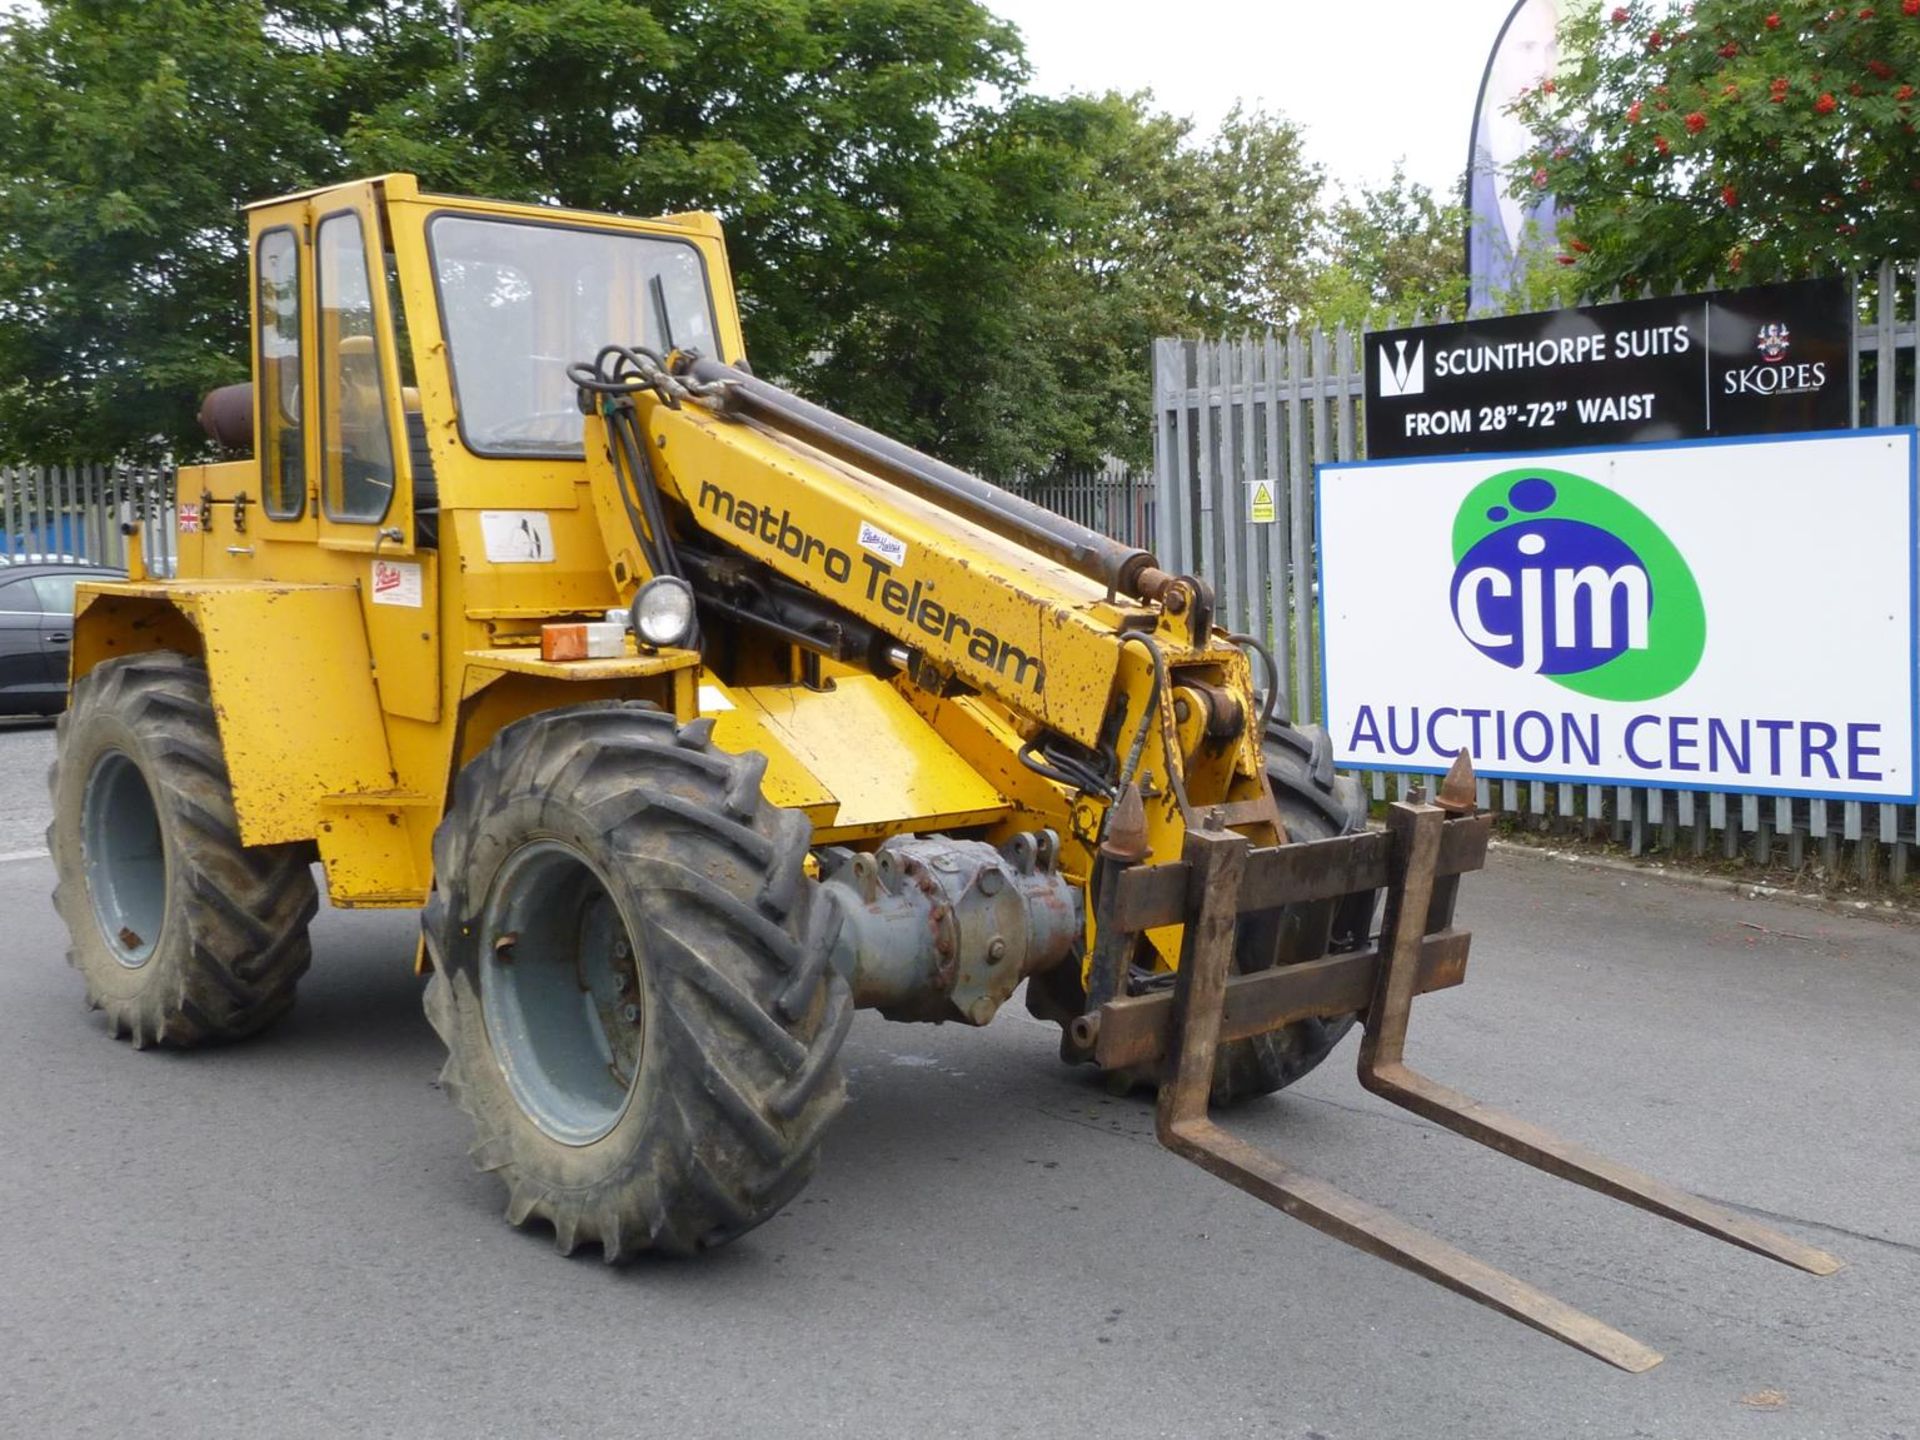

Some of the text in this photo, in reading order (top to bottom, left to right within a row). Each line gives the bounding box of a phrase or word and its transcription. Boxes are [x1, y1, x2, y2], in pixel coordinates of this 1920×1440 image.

[1434, 325, 1690, 377] SCUNTHORPE SUITS
[1724, 362, 1826, 395] SKOPES
[1405, 409, 1472, 437] FROM
[1577, 394, 1655, 423] WAIST
[698, 479, 1046, 694] matbro Teleram
[1457, 533, 1650, 674] cjm
[1348, 704, 1884, 782] AUCTION CENTRE
